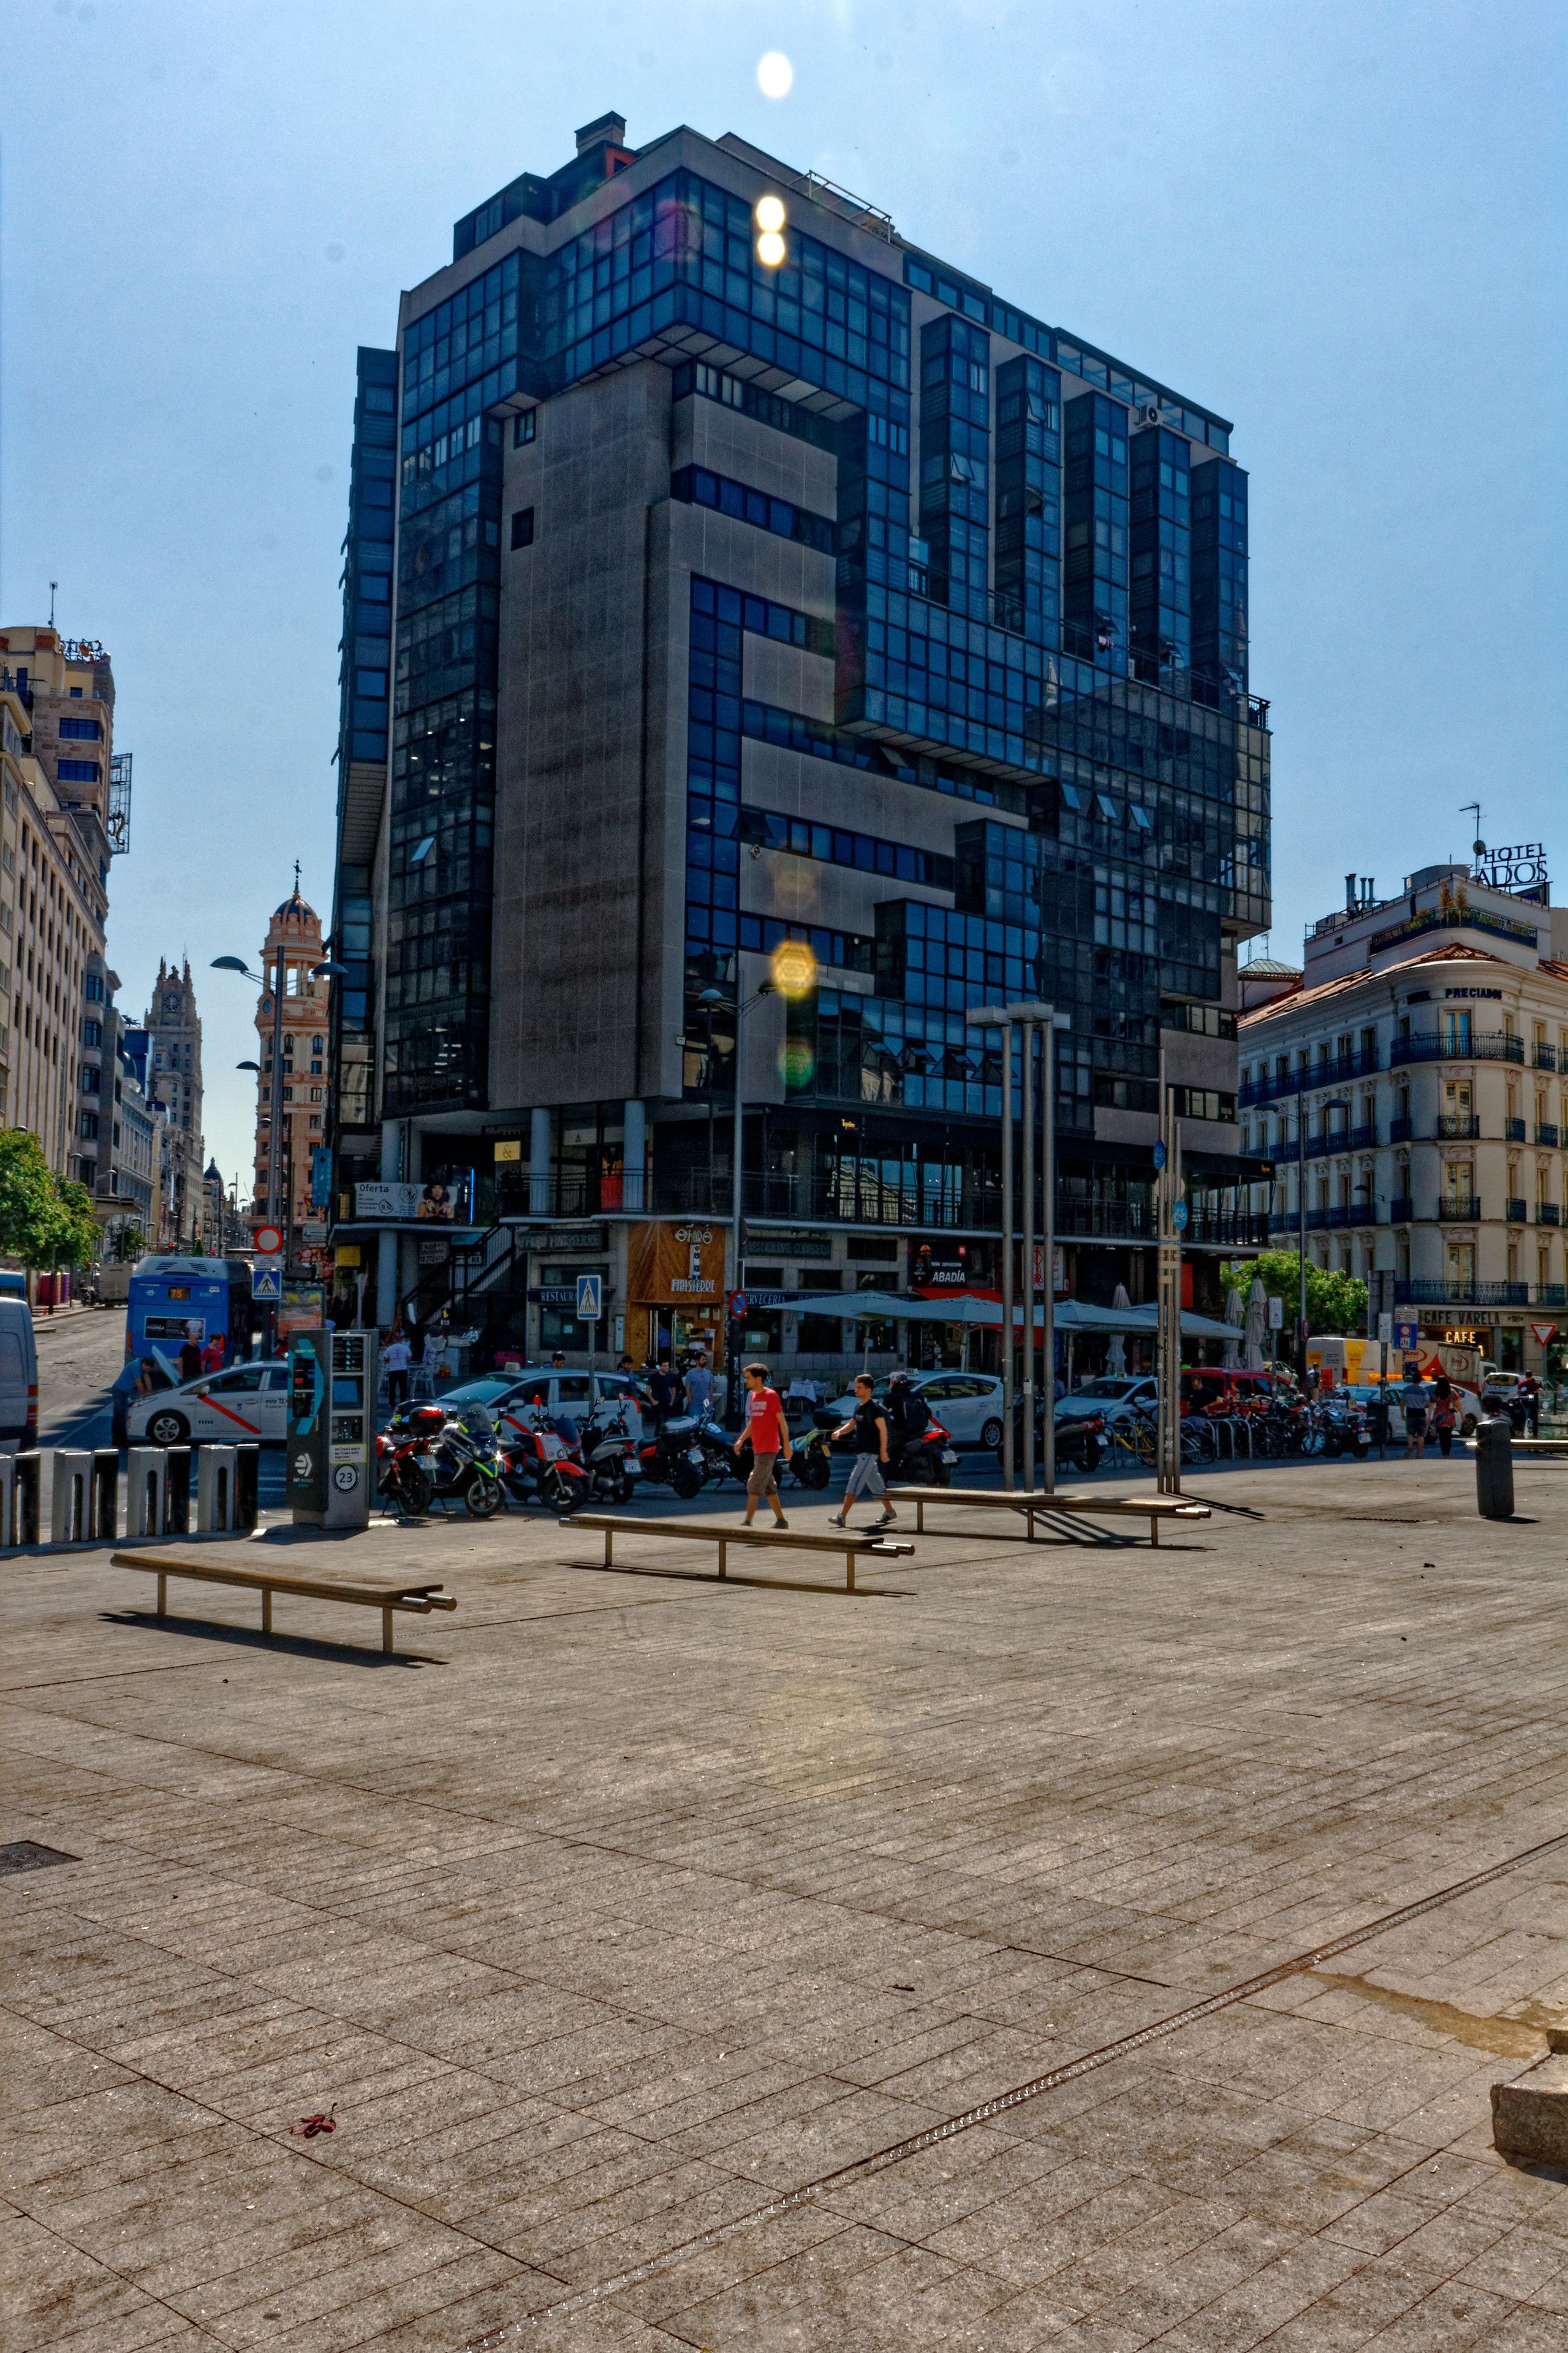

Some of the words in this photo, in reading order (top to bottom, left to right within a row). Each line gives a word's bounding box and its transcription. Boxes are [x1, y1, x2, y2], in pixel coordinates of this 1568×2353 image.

[1483, 843, 1547, 864] HOTEL
[360, 1184, 389, 1192] Oferta
[932, 1270, 966, 1283] ABADÍA
[170, 1288, 183, 1299] 75
[1424, 1311, 1452, 1324] CAFE
[1458, 1311, 1500, 1325] VARELA
[1445, 1331, 1476, 1344] CAFE
[339, 1472, 354, 1483] 23
